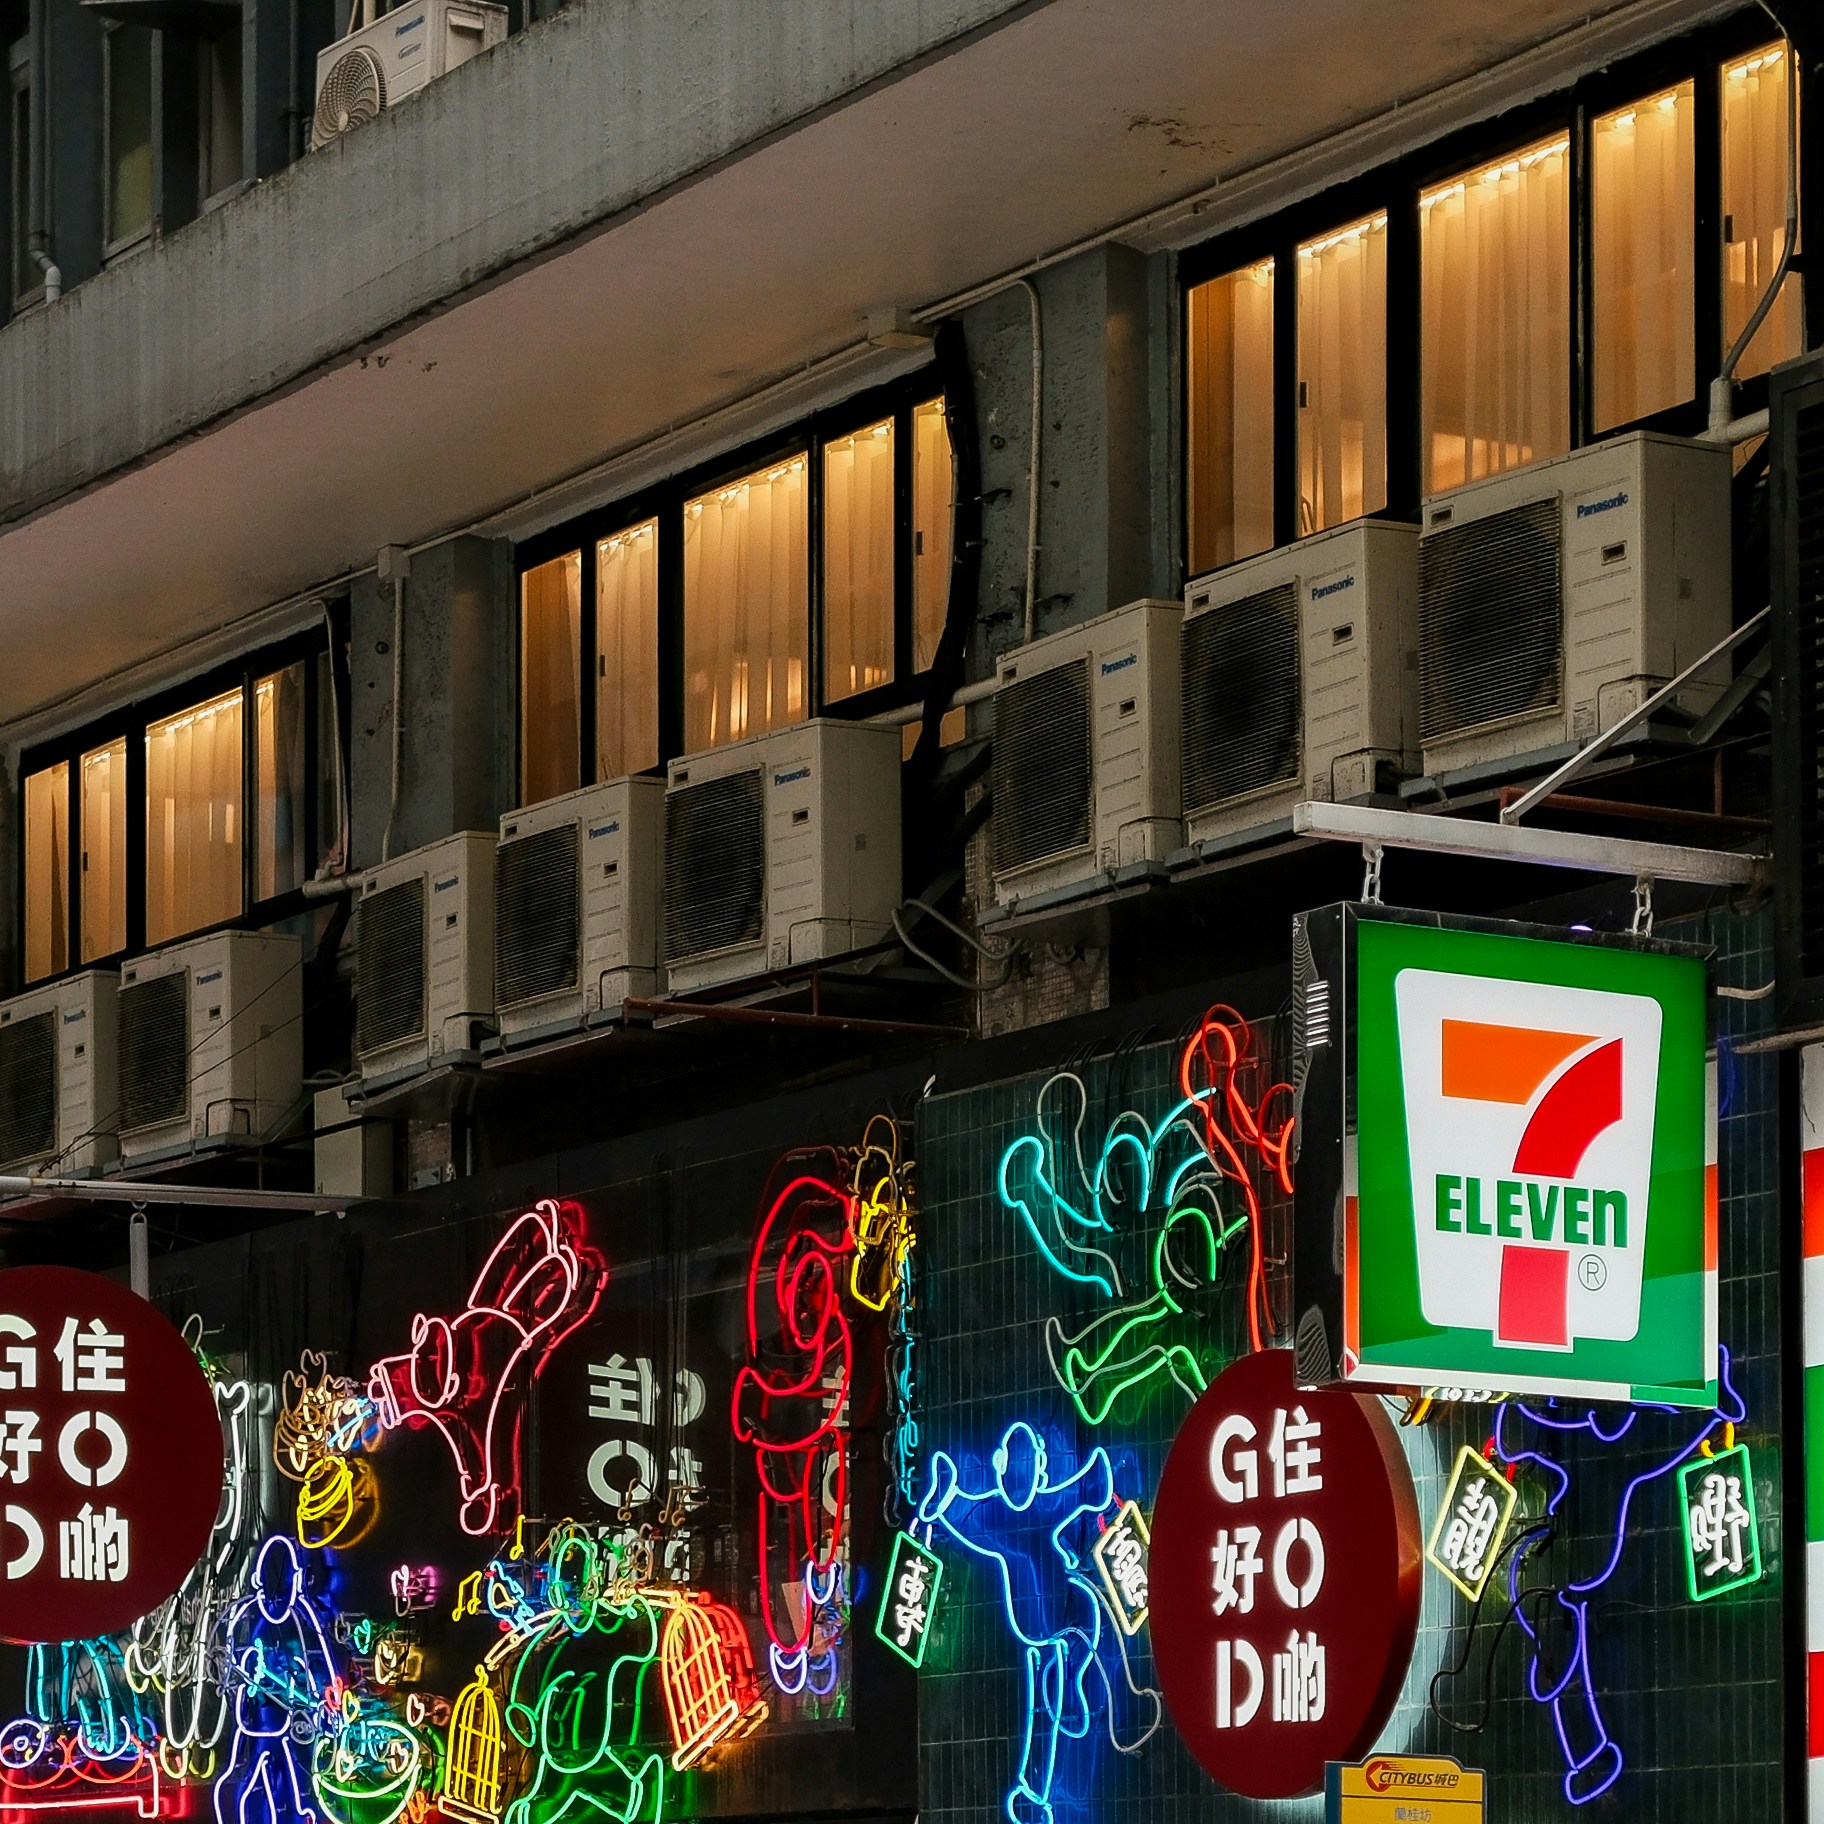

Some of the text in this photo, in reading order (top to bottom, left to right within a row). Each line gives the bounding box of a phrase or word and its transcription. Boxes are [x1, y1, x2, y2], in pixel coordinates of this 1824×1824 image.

[1441, 1018, 1624, 1346] 7
[1379, 1772, 1459, 1786] CITYBUS 城巴
